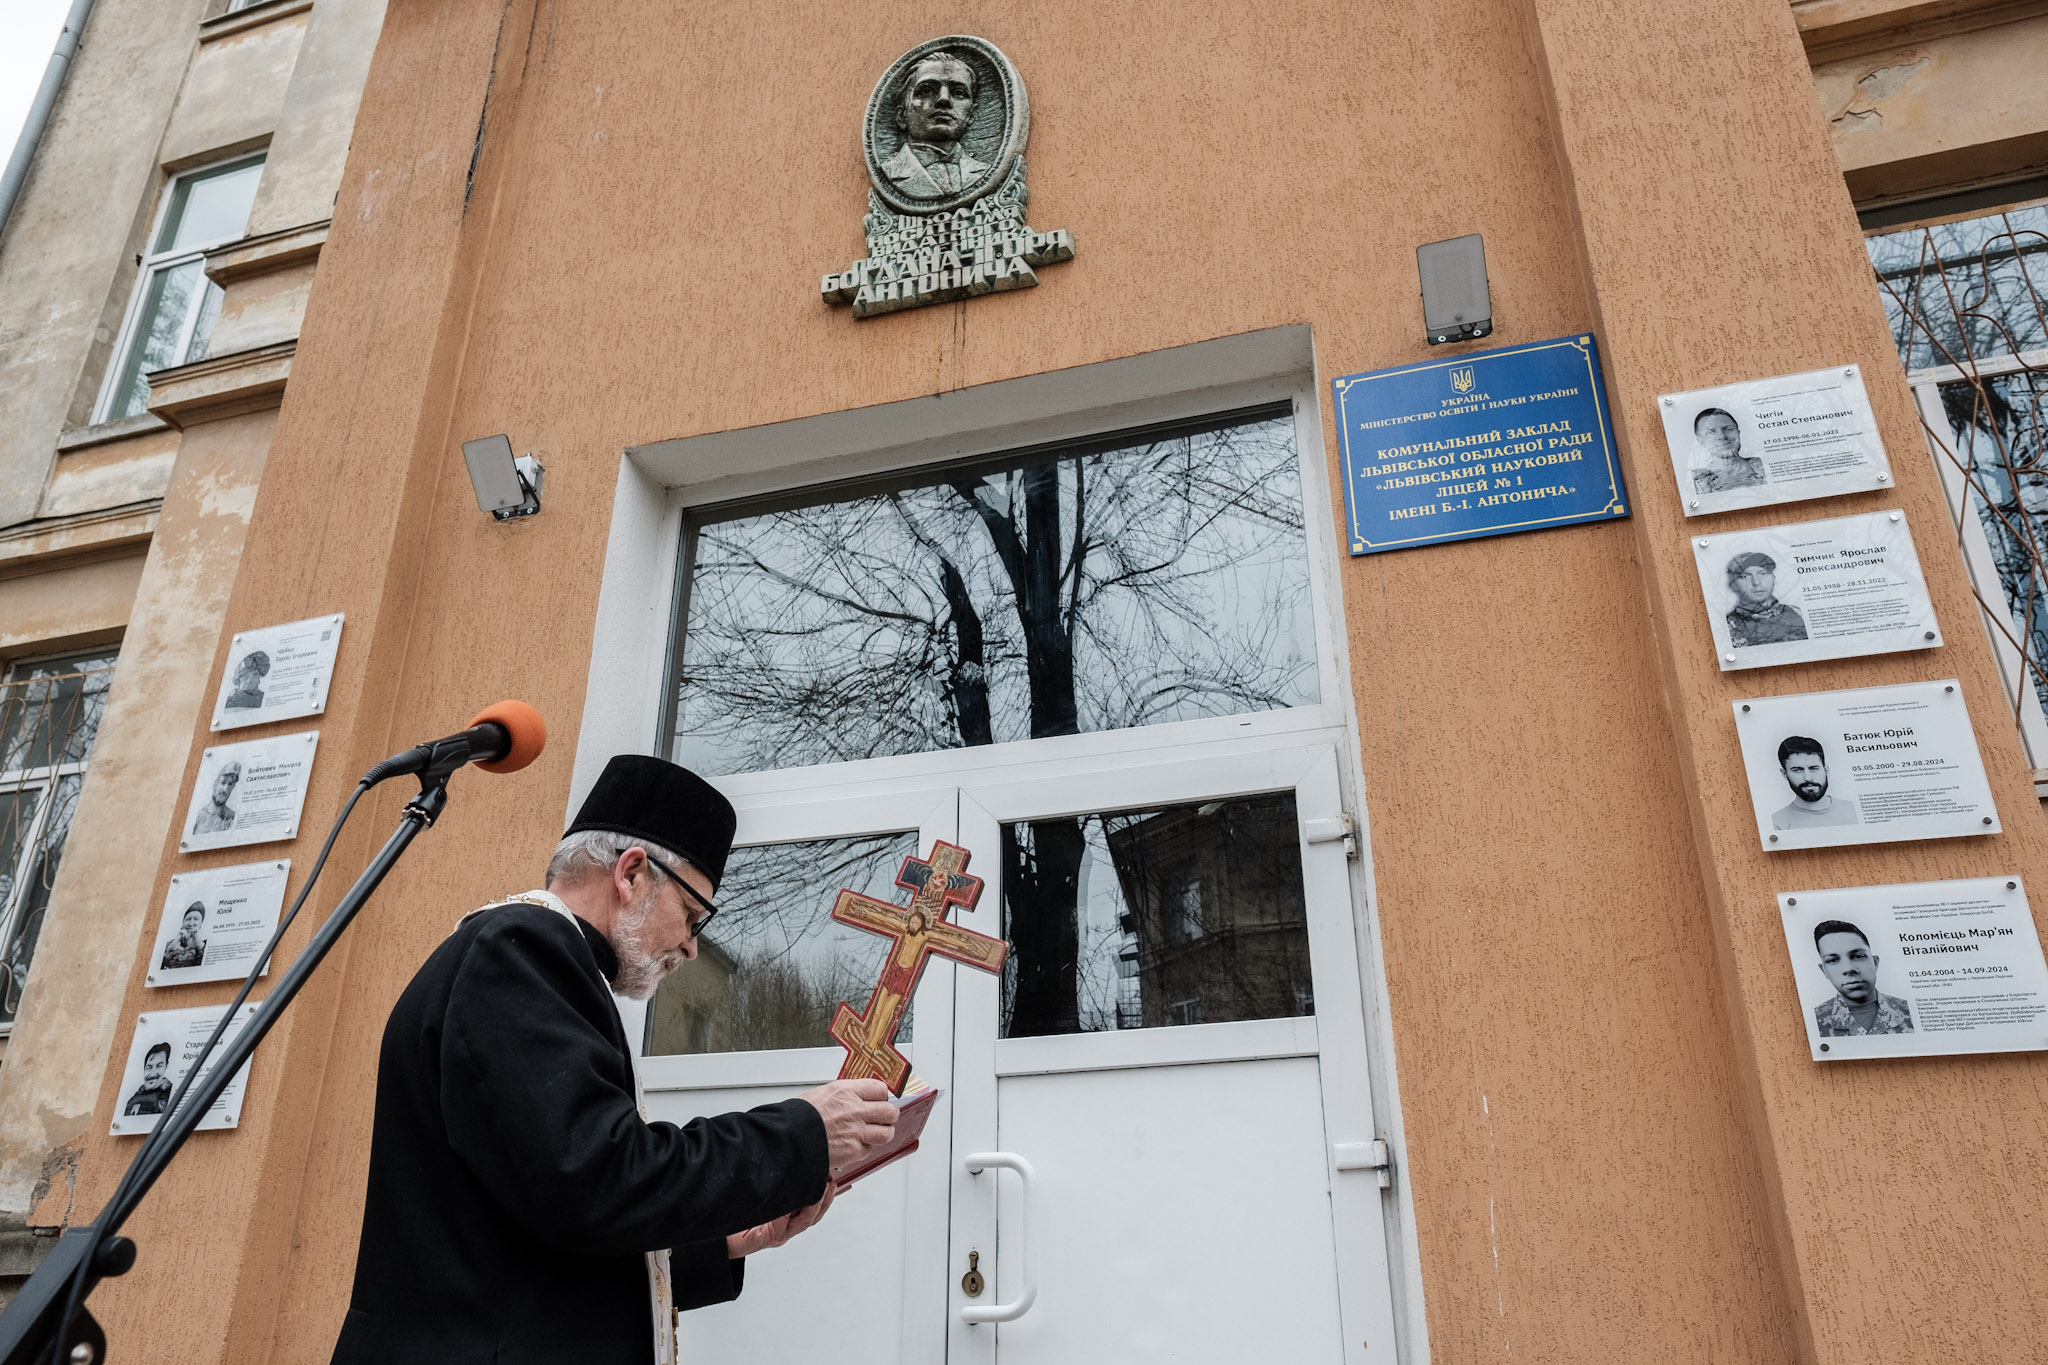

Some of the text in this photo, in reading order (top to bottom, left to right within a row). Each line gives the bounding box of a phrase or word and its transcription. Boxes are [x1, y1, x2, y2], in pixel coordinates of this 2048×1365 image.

[868, 217, 969, 248] НОСИТЬ
[872, 219, 1016, 257] ВИДАТНОГО
[853, 256, 1028, 305] АНТОНИЧА
[1360, 411, 1437, 430] МІНІСТЕРСТВО
[1439, 404, 1479, 417] ОСВІТИ
[1489, 397, 1526, 409] НАУКИ
[1529, 387, 1578, 402] УКРАЇНИ
[1441, 393, 1490, 407] УКРАЇНА
[1756, 410, 1783, 420] Чигін
[1758, 410, 1853, 429] Остап Степанович
[1377, 420, 1571, 461] КОМУНАЛЬНИЙ ЗАКЛАД
[1360, 432, 1593, 478] ЛЬВІВСЬКОЇ ОБЛАСНОЇ РАДИ
[1375, 449, 1583, 491] «ЛЬВІВСЬКИЙ НАУКОВИЙ
[1436, 475, 1523, 498] ЛІЦЕЙ № 1
[1389, 485, 1576, 521] ІМЕНІ Б.-І. АНТОНИЧА»
[1794, 545, 1887, 563] Тимчик Ярослав
[1797, 558, 1884, 574] Олександрович
[1844, 727, 1914, 741] Батюк Юрій
[1847, 741, 1918, 753] Васильович
[1852, 763, 1895, 771] 05.05.2000
[1902, 759, 1944, 767] 29.08.2024
[219, 898, 247, 906] Мощенко
[1899, 931, 1966, 942] Коломієць
[1903, 944, 1979, 956] Віталійович
[1909, 969, 1955, 977] 01.04.2004
[1962, 966, 2008, 974] 14.09.2024
